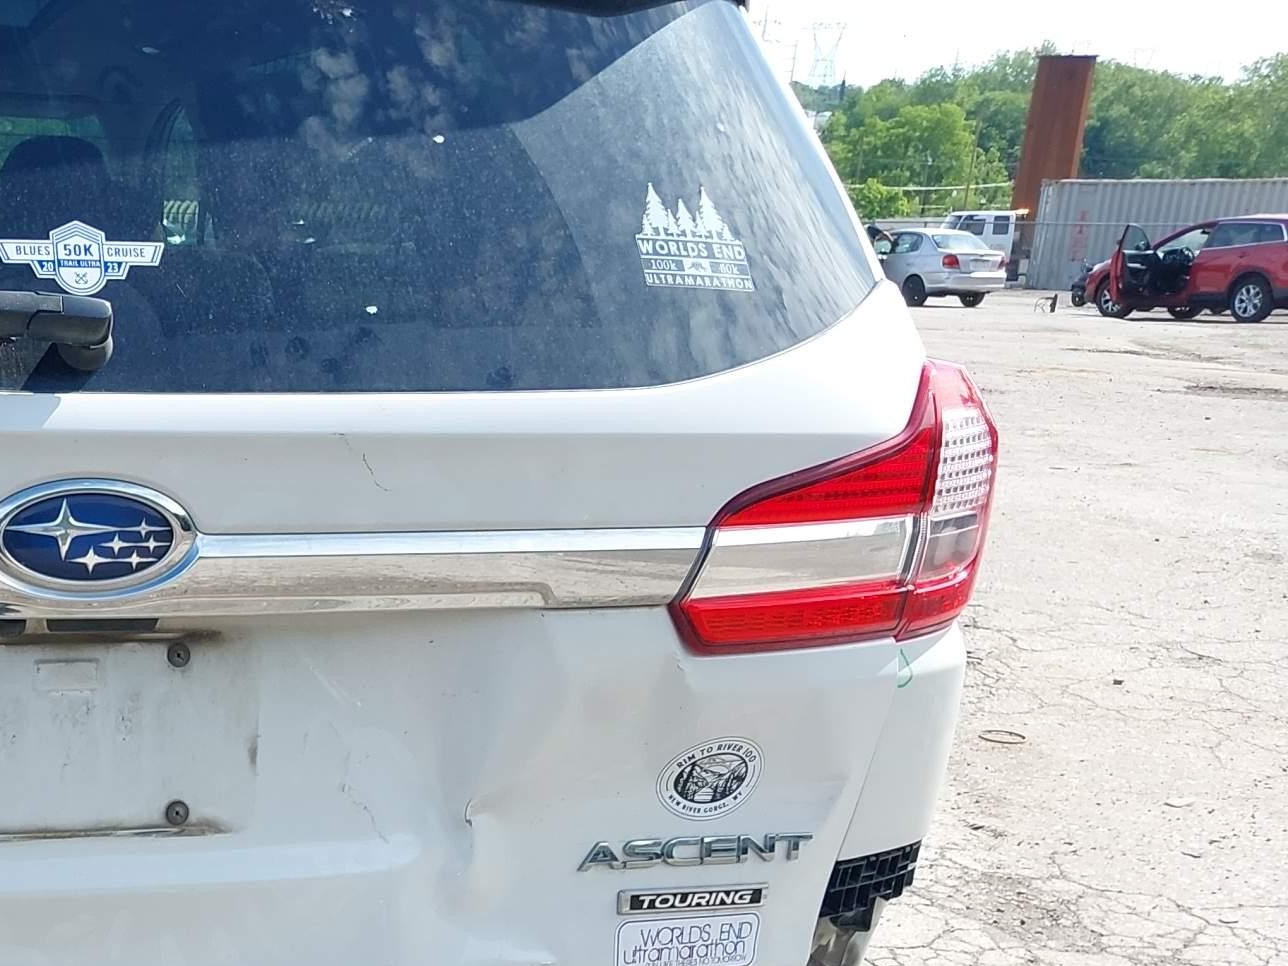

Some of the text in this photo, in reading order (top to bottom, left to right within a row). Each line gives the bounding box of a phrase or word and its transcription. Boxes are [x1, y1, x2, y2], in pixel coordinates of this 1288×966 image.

[15, 245, 51, 256] BLUES
[63, 243, 94, 257] 50K
[107, 246, 146, 258] CRUISE
[638, 239, 746, 260] WORLDS END
[42, 261, 54, 273] 20
[80, 260, 101, 268] ULTRA
[107, 262, 119, 273] 23
[645, 274, 753, 287] ULTRAMARATHON
[676, 743, 757, 769] RIM TO RIVER 100
[668, 793, 681, 807] NEW
[682, 803, 702, 814] RIVER
[576, 832, 814, 872] ASCENT
[639, 890, 754, 909] TOURING
[640, 921, 753, 947] WORLDS END
[623, 938, 746, 965] ultramarathon
